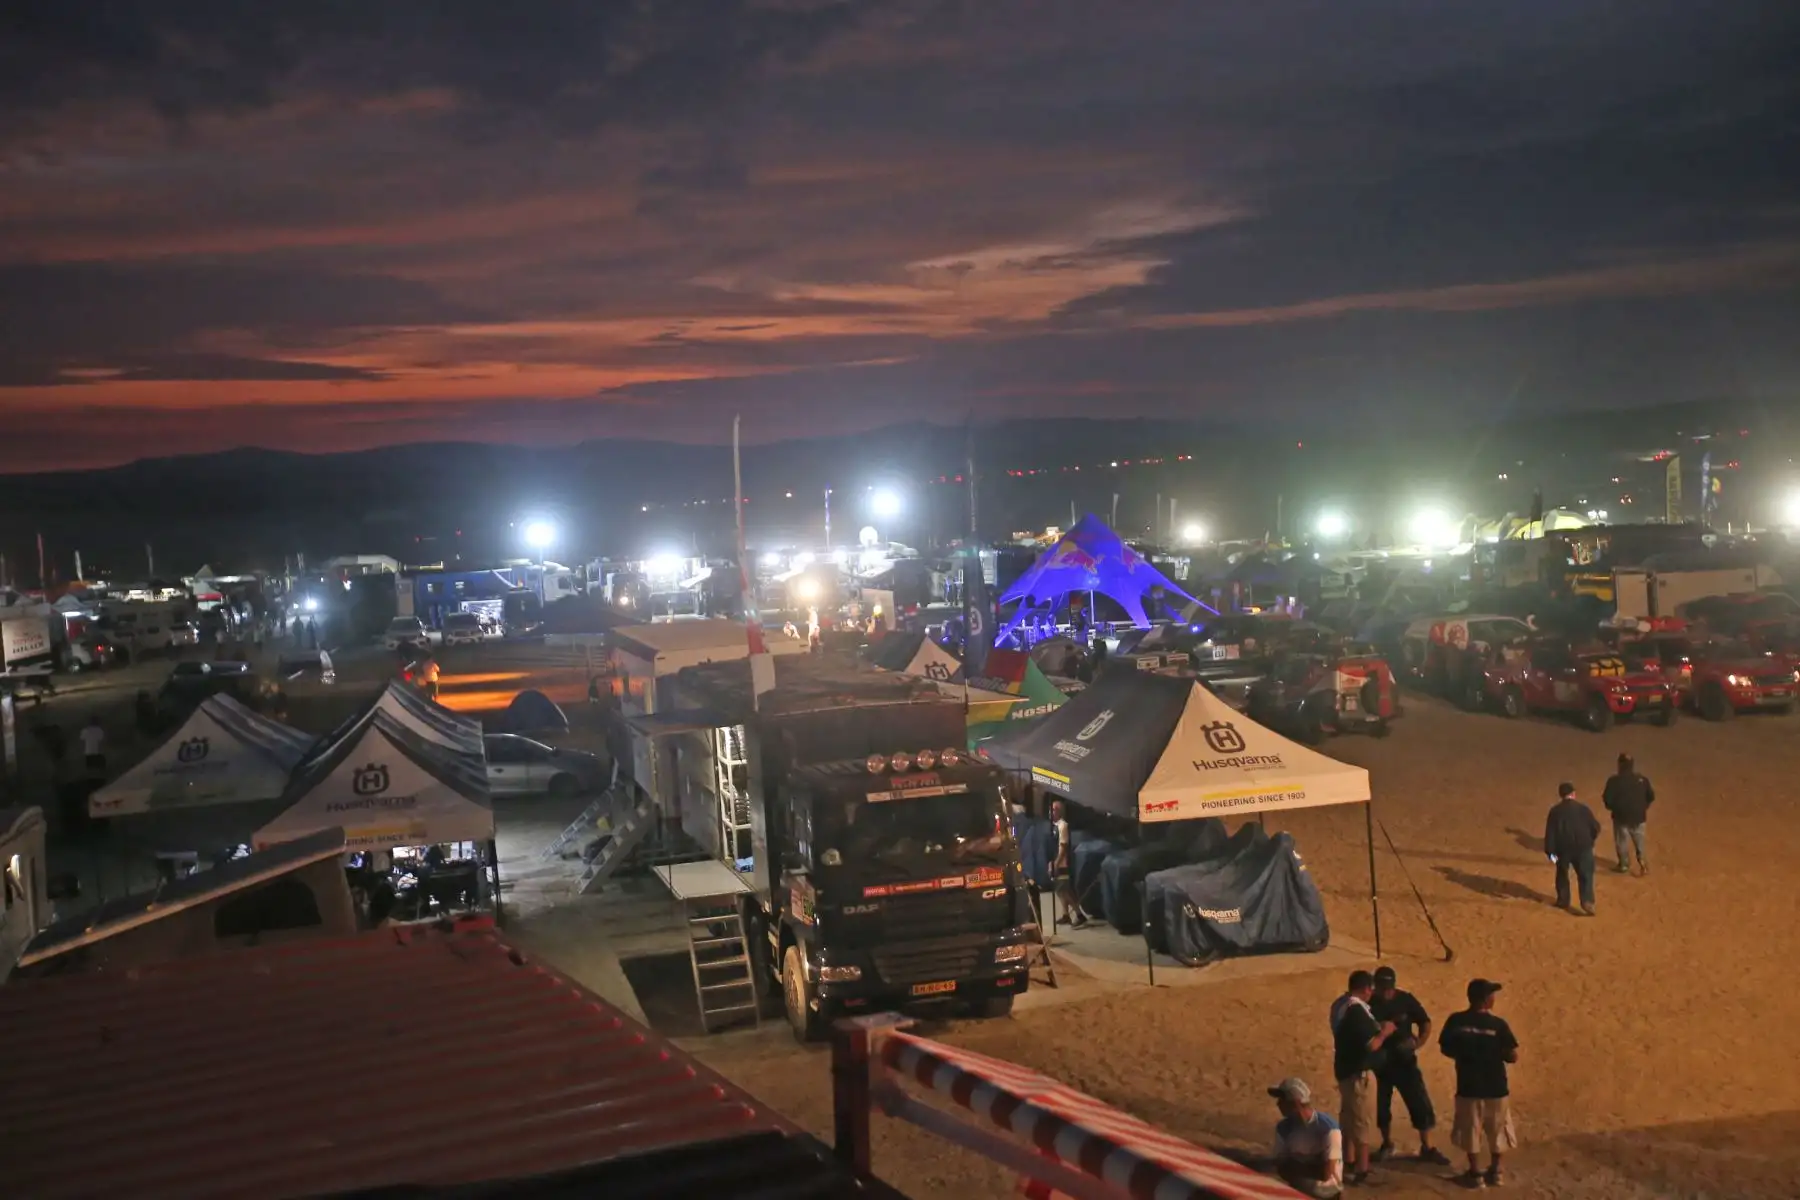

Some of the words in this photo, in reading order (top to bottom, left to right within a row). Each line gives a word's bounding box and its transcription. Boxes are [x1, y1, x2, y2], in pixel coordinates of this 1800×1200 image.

[1192, 755, 1282, 771] Husqvarna
[1201, 797, 1256, 810] PIONEERING
[1258, 794, 1285, 804] SINCE
[1287, 792, 1306, 800] 1903
[843, 904, 879, 914] DAF
